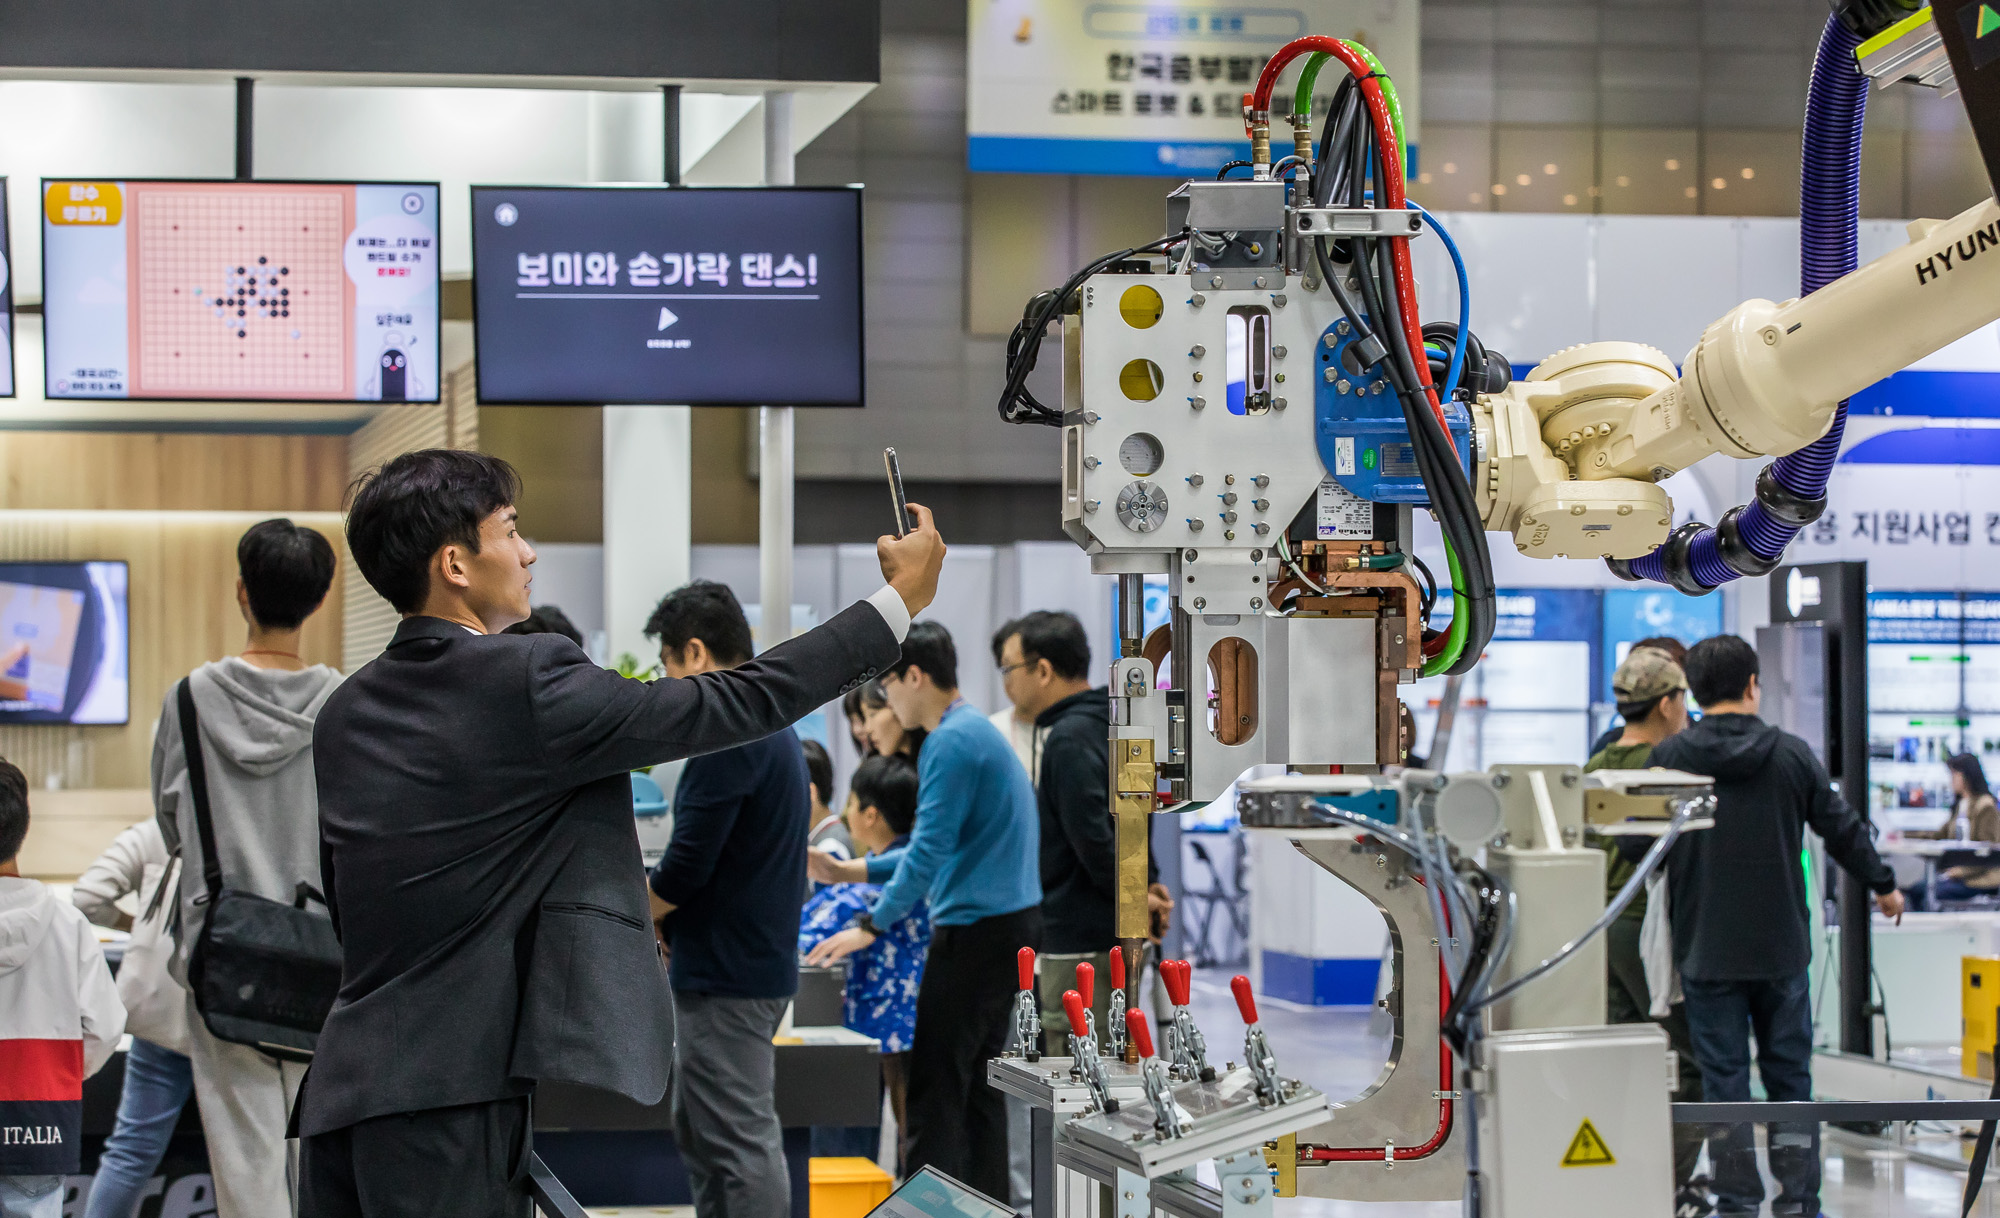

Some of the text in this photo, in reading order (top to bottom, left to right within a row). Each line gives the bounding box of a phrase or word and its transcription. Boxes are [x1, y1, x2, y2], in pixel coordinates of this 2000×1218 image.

[516, 251, 818, 288] 보미와 손가락 댄스!
[1914, 219, 2000, 286] HYUN
[1852, 510, 1971, 545] 지원사업
[3, 1125, 63, 1145] ITALIA
